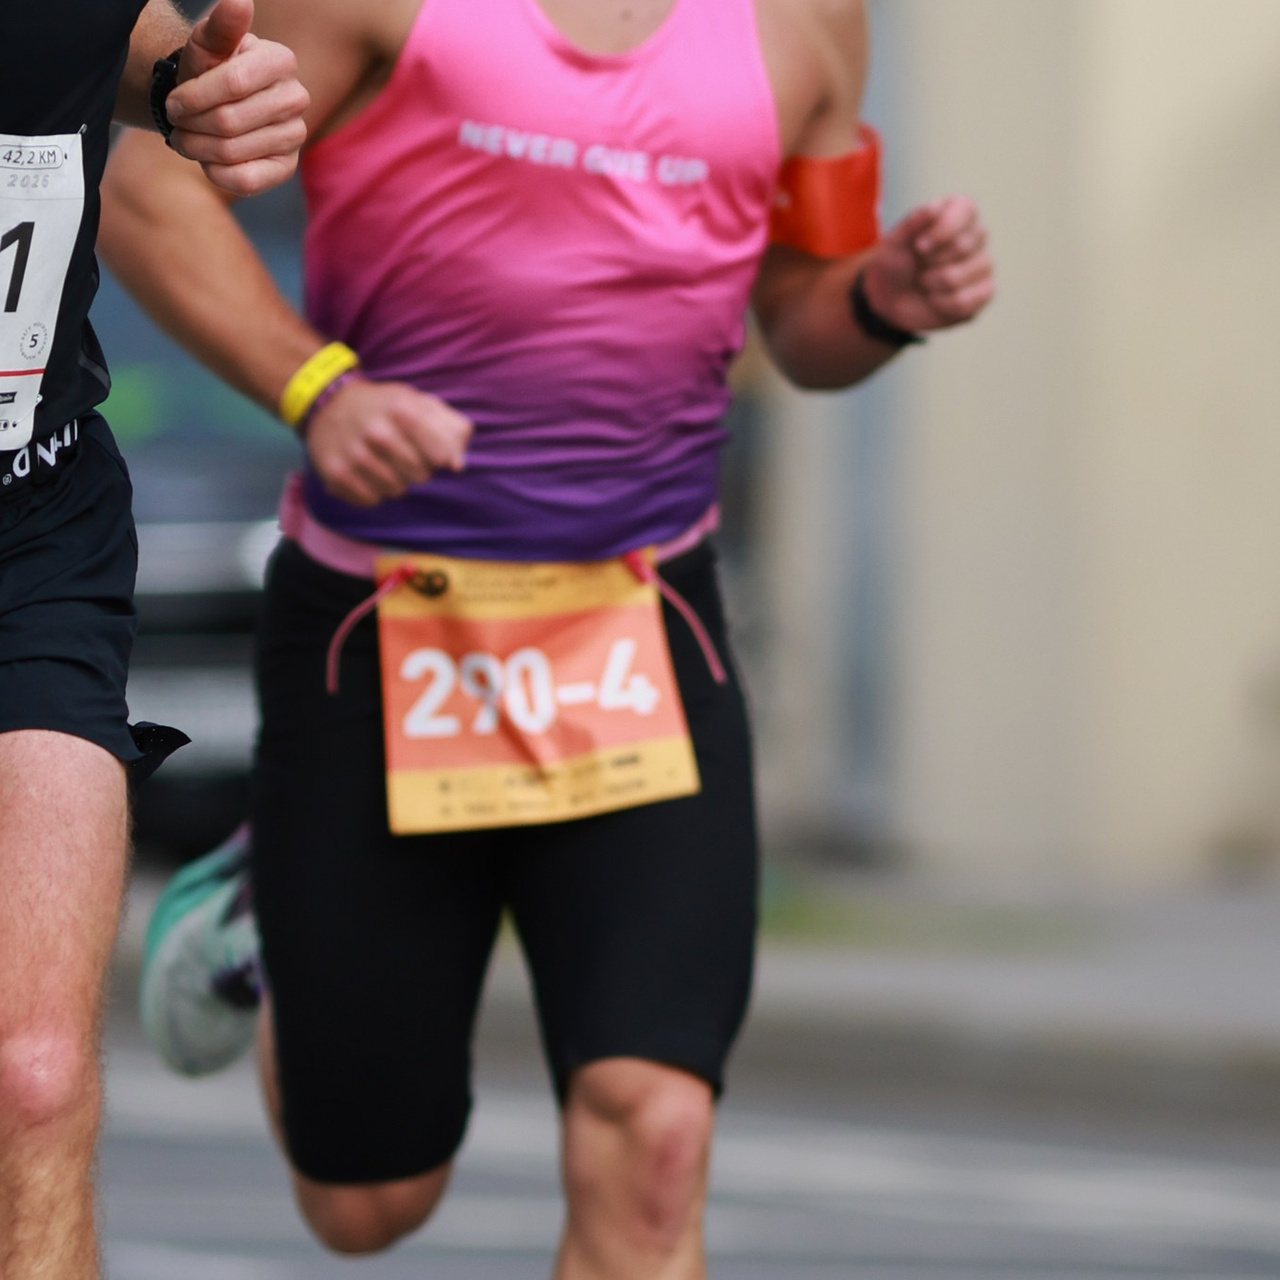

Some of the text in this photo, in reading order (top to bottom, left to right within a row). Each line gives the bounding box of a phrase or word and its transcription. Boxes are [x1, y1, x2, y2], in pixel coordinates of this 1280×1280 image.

[2, 150, 35, 166] 42,2
[459, 121, 577, 166] NEVER
[657, 155, 709, 187] UP
[29, 333, 39, 348] 5
[399, 637, 660, 739] 290-4
